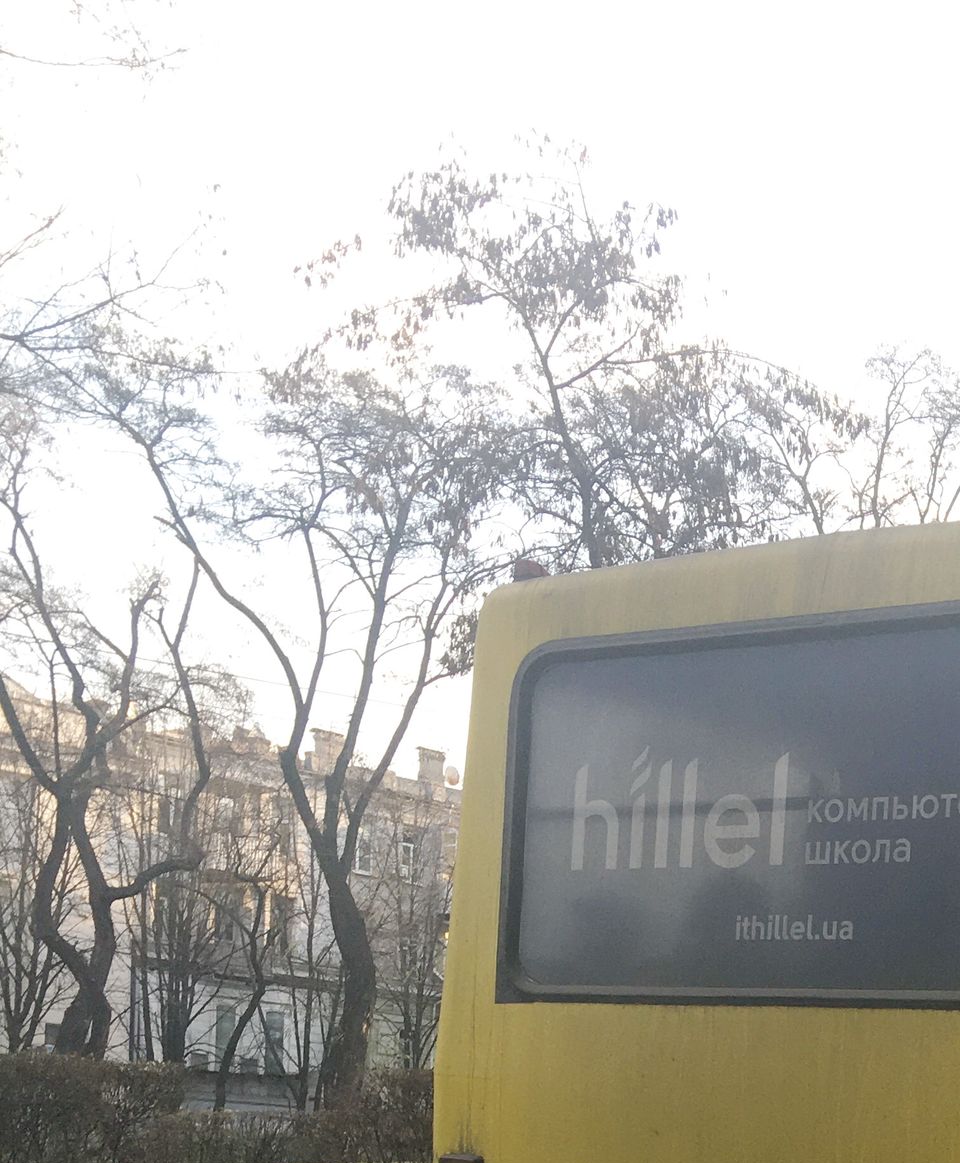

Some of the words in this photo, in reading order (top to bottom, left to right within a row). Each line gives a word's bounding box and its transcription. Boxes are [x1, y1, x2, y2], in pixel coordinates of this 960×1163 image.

[571, 745, 790, 871] hillel
[804, 838, 911, 865] школа
[735, 914, 854, 940] ithillel.ua
